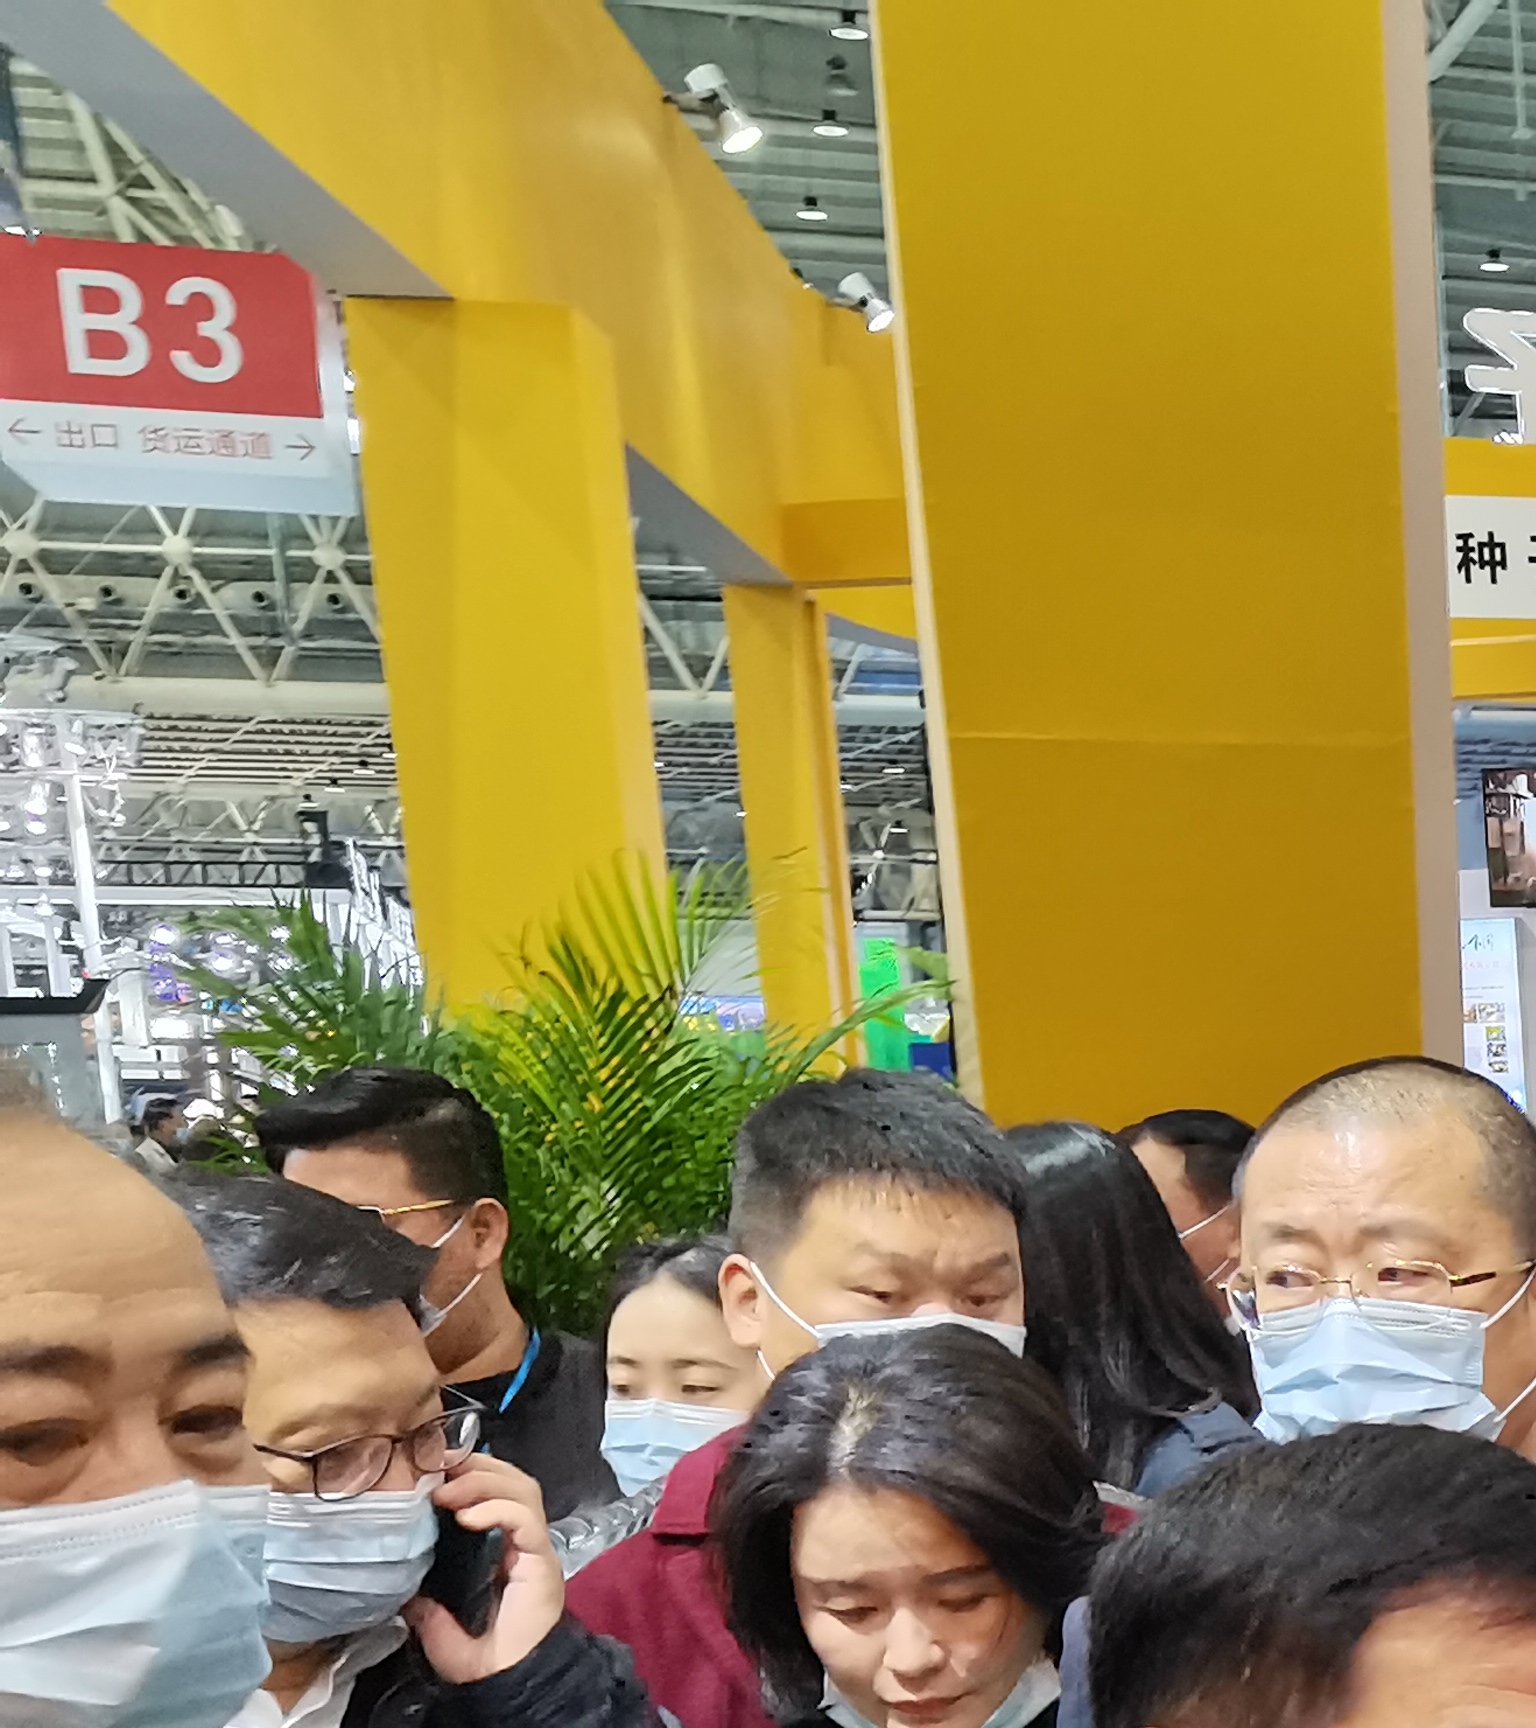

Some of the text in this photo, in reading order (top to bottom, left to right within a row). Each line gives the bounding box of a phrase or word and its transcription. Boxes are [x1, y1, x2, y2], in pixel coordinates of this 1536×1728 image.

[57, 268, 244, 383] B3
[55, 420, 272, 460] 出口 货运通道
